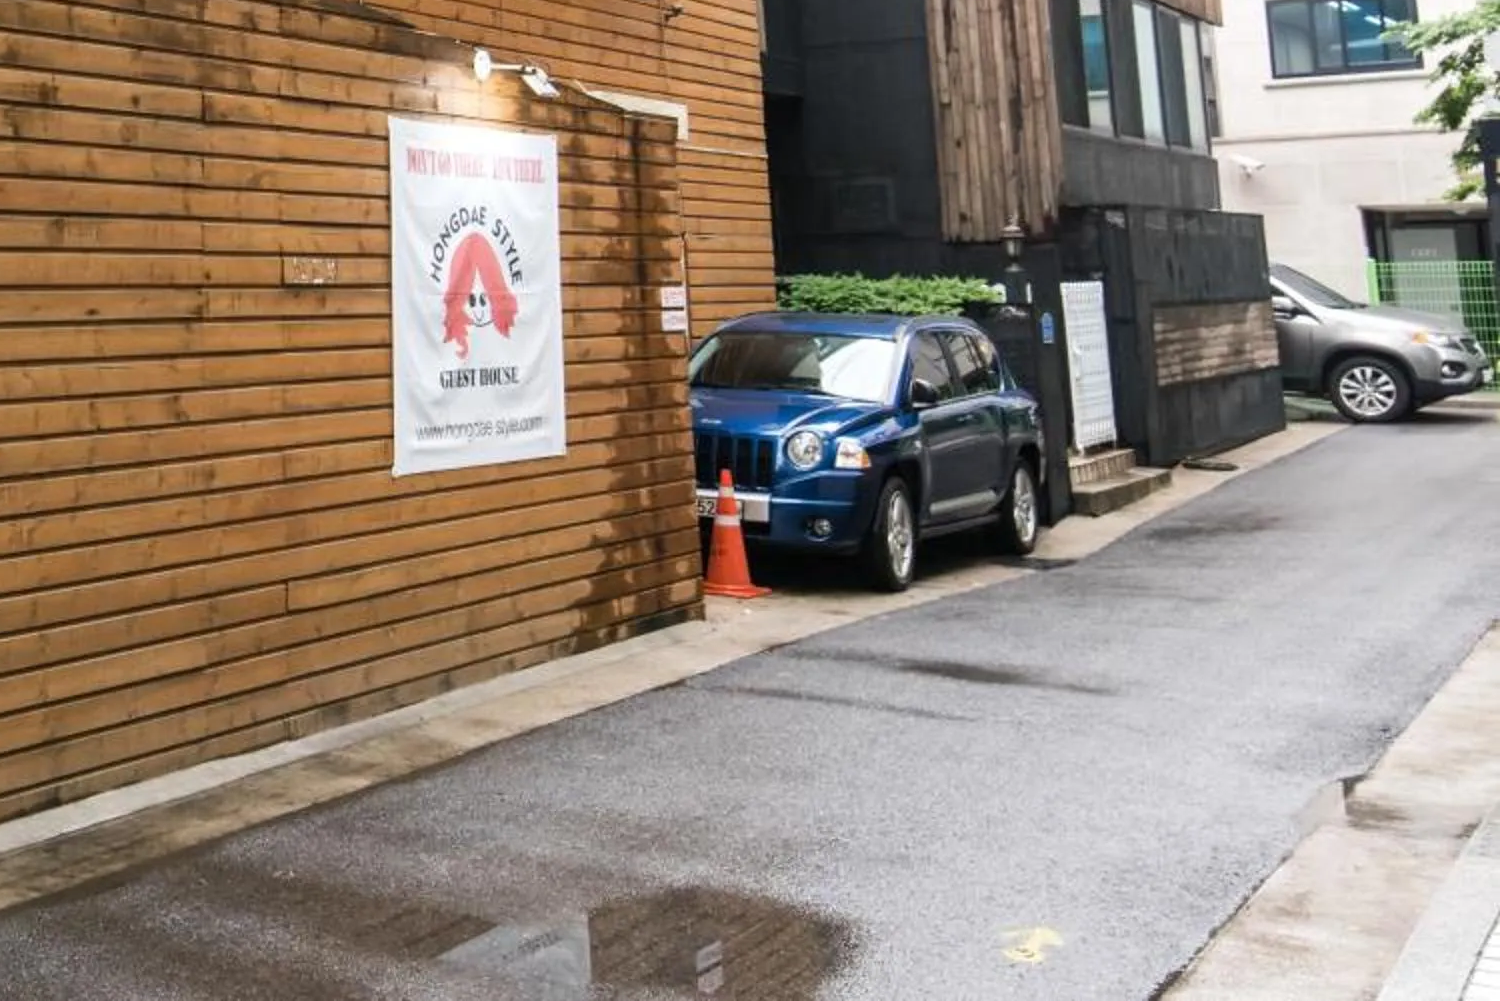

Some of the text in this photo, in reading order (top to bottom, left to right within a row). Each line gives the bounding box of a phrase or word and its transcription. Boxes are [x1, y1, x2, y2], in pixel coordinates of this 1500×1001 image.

[429, 205, 523, 287] HONGDAE STYLE
[439, 365, 520, 390] GUEST HOUSE
